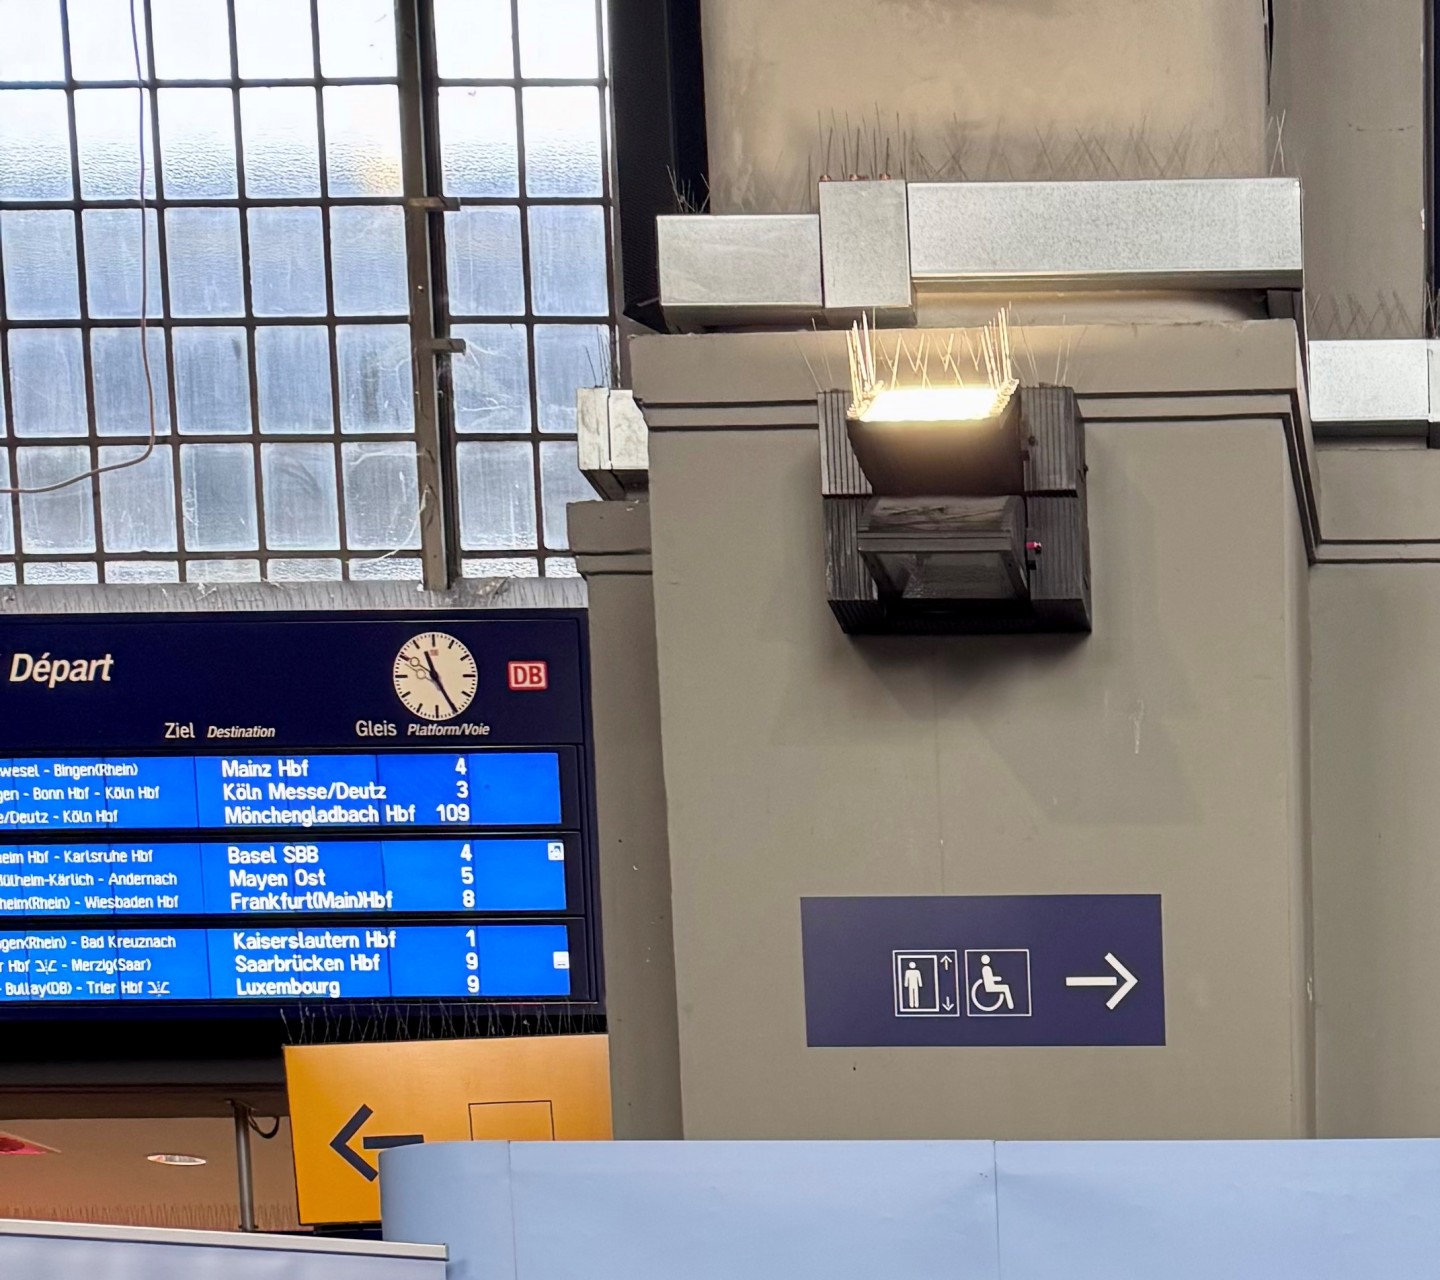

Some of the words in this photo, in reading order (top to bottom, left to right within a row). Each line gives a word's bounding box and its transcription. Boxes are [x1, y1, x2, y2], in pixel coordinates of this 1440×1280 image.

[9, 653, 114, 688] Départ
[512, 664, 543, 686] DB
[164, 721, 195, 740] Ziel
[207, 724, 276, 740] Destination
[355, 719, 397, 737] Gleis
[407, 721, 490, 738] Platform/Voie
[53, 763, 139, 780] Bingen(Rhein)
[221, 760, 272, 778] Mainz
[278, 759, 309, 777] Hbf
[455, 757, 467, 775] 4
[32, 787, 64, 800] Bonn
[68, 787, 90, 800] Hbf
[105, 786, 134, 799] Köln
[138, 786, 160, 799] Hbf
[223, 783, 262, 800] Köln
[268, 781, 387, 800] Messe/Deutz
[456, 780, 469, 798] 3
[63, 810, 92, 823] Köln
[95, 809, 118, 822] Hbf
[225, 805, 379, 827] Mönchengladbach
[385, 805, 416, 822] Hbf
[435, 804, 470, 822] 109
[28, 851, 49, 864] Hbf
[64, 850, 128, 863] Karlsruhe
[131, 849, 153, 863] Hbf
[228, 846, 277, 864] Basel
[283, 845, 319, 864] SBB
[460, 843, 473, 861] 4
[108, 872, 178, 886] Andernach
[229, 870, 288, 890] Mayen
[294, 868, 326, 886] Ost
[461, 866, 474, 885] 5
[84, 895, 153, 909] Wiesbaden
[157, 895, 179, 908] Hbf
[231, 890, 393, 910] Frankfurt(Main)Hbf
[462, 889, 476, 908] 8
[81, 936, 104, 949] Bad
[108, 935, 176, 948] Kreuznach
[233, 931, 360, 950] Kaiserslautern
[365, 930, 397, 948] Hbf
[465, 929, 476, 947] 1
[8, 960, 30, 973] Hbf
[71, 958, 151, 974] Merzig(Saar)
[235, 954, 344, 973] Saarbrücken
[350, 953, 380, 972] Hbf
[465, 952, 479, 970] 9
[5, 982, 73, 998] Bullay(DB)
[86, 981, 116, 994] Trier
[120, 981, 143, 994] Hbf
[236, 978, 341, 998] Luxembourg
[467, 975, 480, 993] 9
